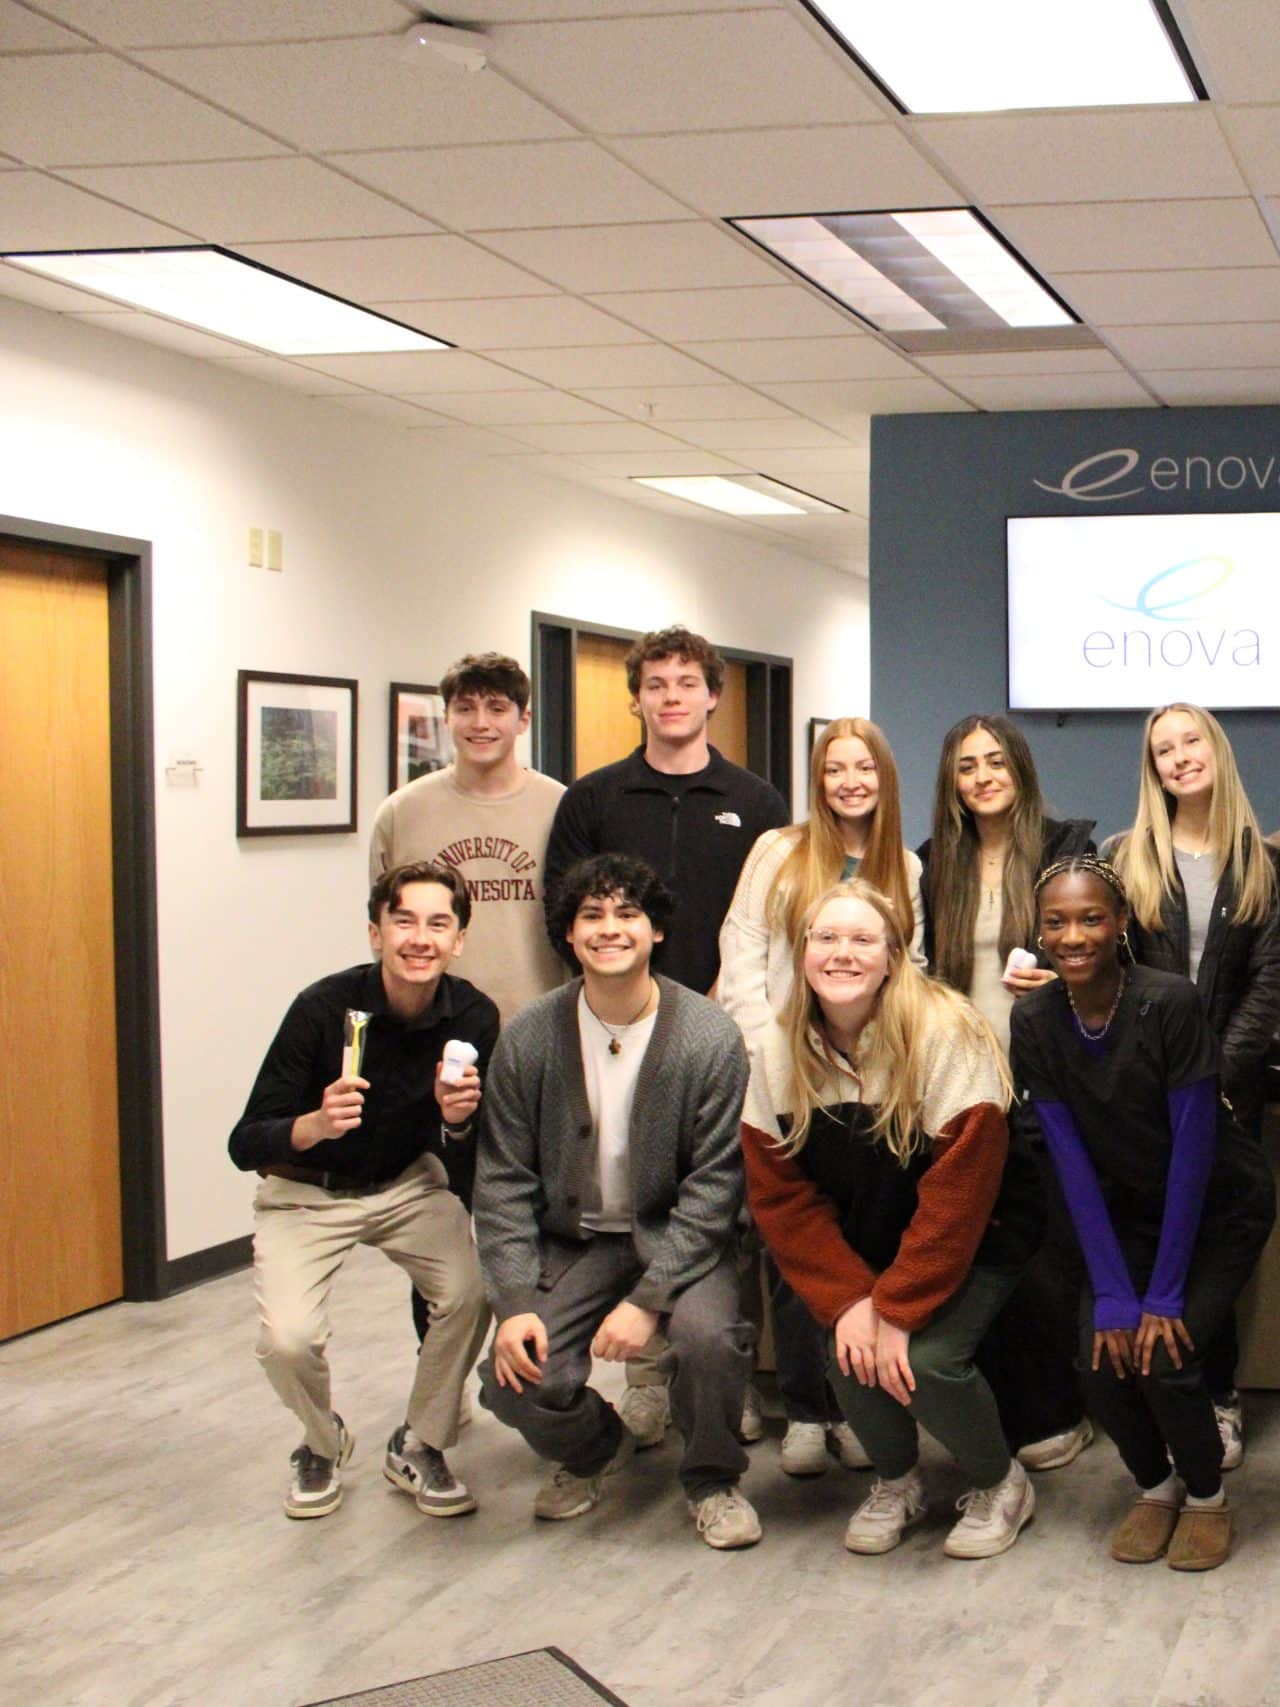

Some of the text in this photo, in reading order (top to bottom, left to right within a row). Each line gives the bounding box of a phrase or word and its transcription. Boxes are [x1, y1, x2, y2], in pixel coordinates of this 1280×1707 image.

[1083, 628, 1260, 668] enova
[432, 837, 537, 873] NIVERSITY OF
[465, 879, 536, 901] NESOTA
